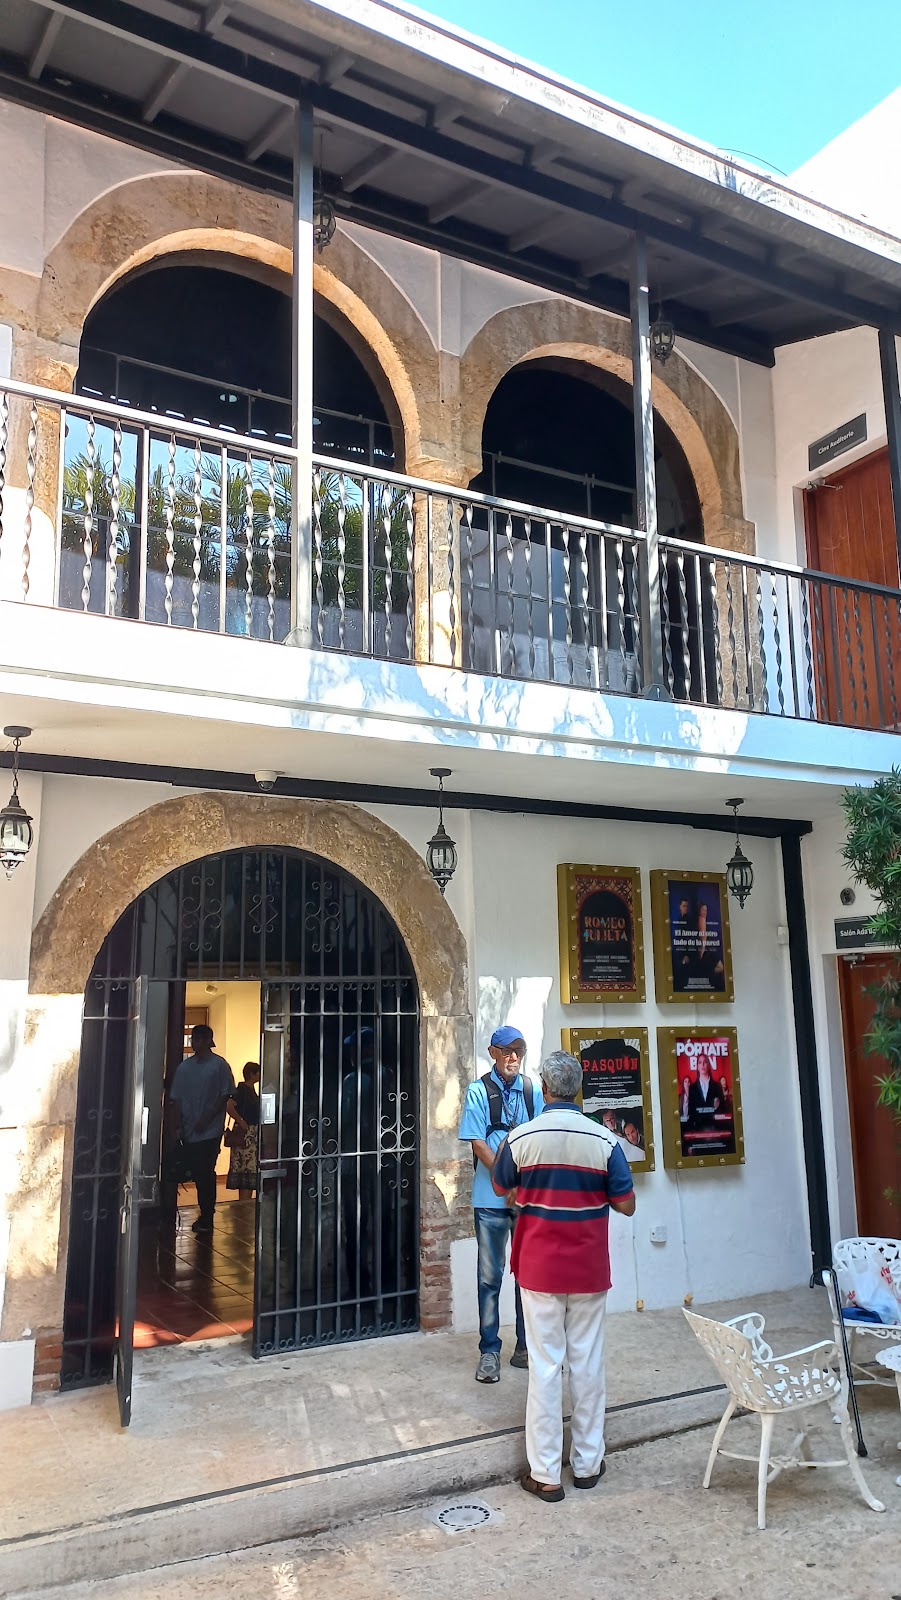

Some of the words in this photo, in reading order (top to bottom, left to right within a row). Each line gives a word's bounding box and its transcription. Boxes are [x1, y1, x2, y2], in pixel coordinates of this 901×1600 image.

[818, 444, 829, 454] Cine
[830, 431, 854, 448] Auditorio
[584, 916, 625, 928] ROMEO
[584, 929, 627, 942] JULIETA
[681, 929, 698, 937] Amor
[673, 938, 688, 946] lado
[677, 1038, 728, 1056] PÓRTATE
